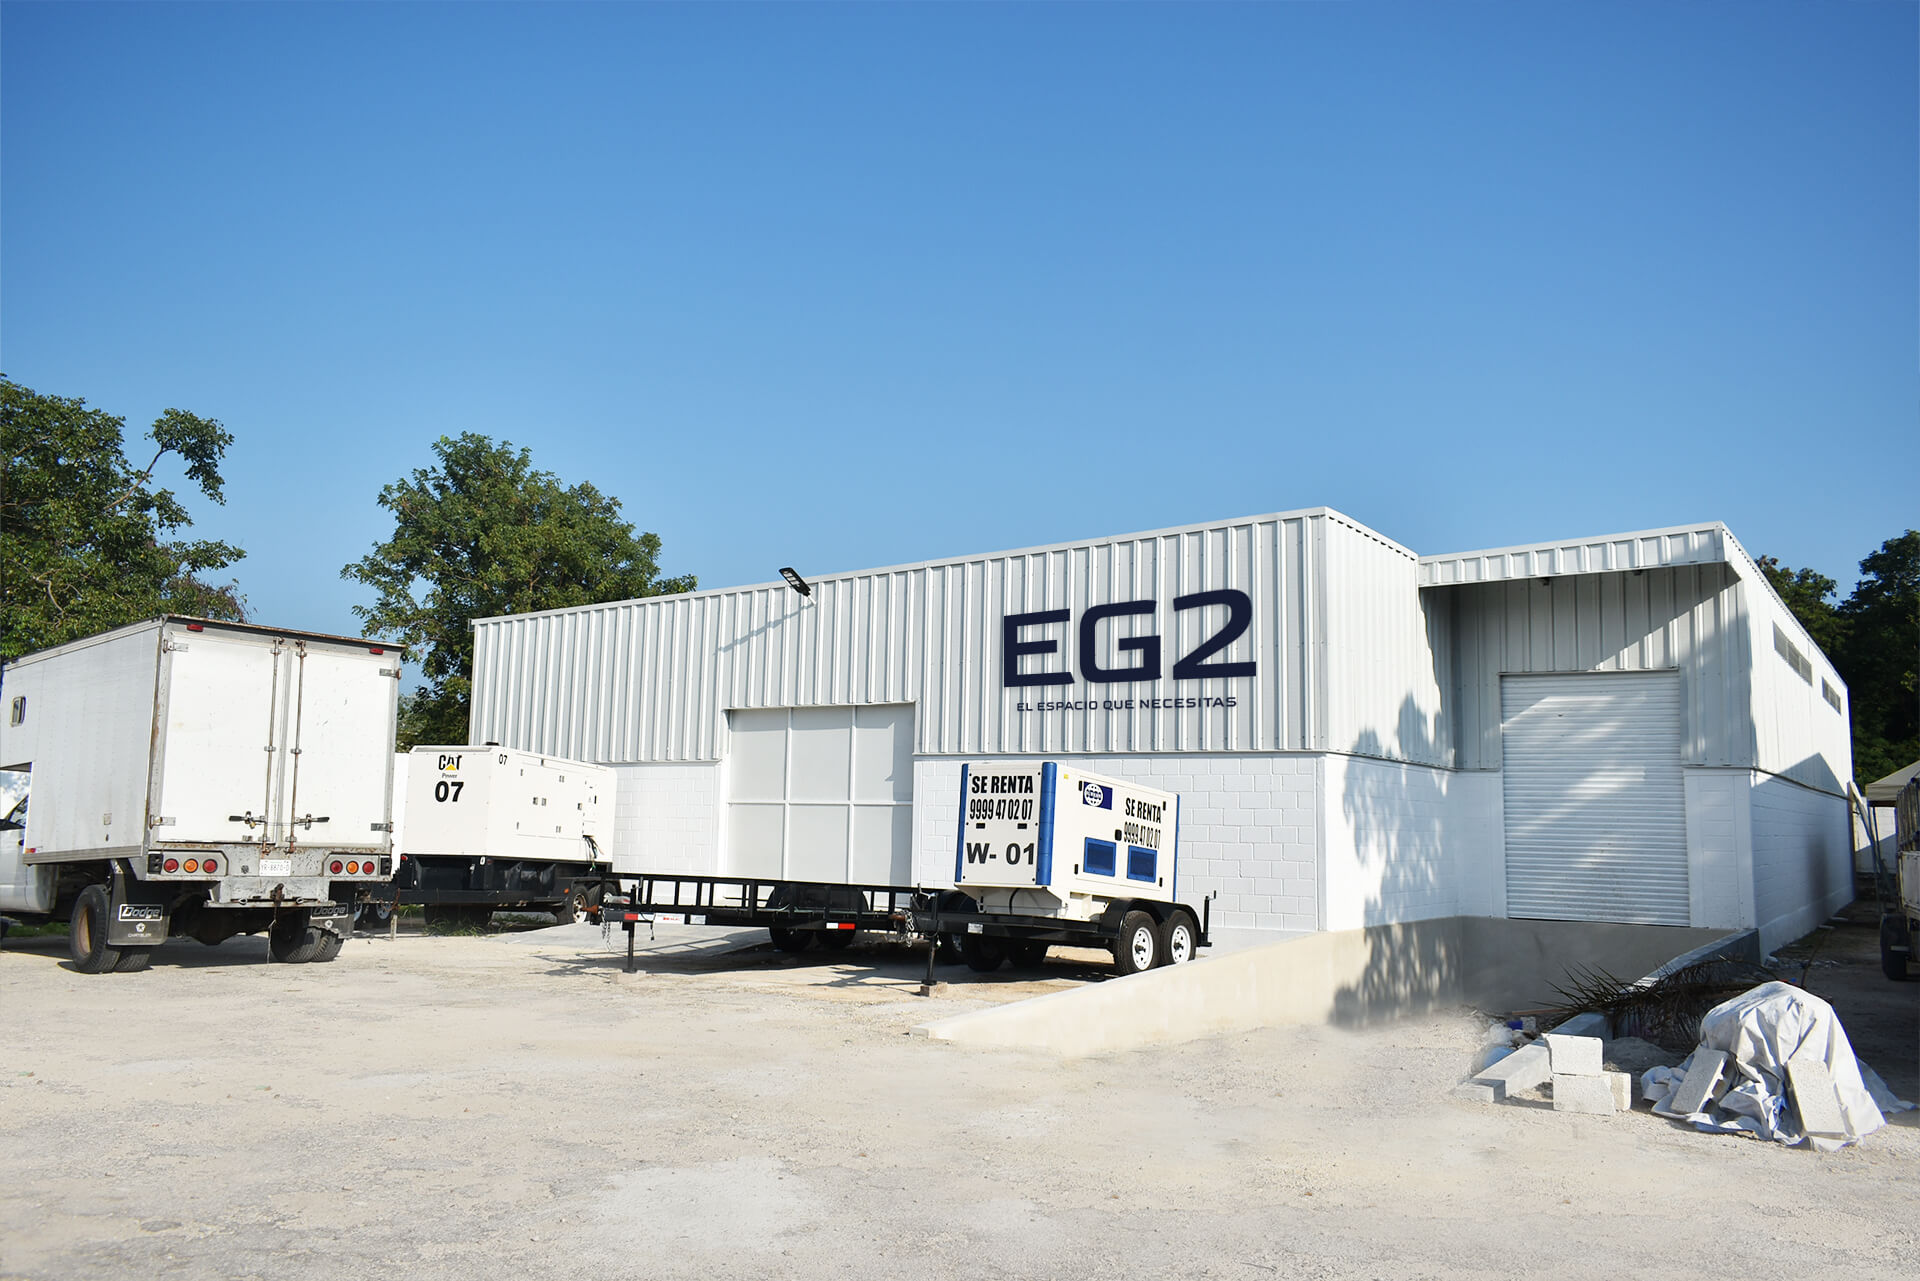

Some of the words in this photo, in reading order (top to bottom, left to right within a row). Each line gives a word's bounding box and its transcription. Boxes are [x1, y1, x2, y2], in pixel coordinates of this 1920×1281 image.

[1003, 588, 1257, 687] EG2
[1017, 702, 1033, 711] EL
[1037, 701, 1098, 711] ESPACIO
[1103, 699, 1134, 711] QUE
[1140, 697, 1237, 709] NECESITAS
[438, 755, 462, 771] CAT
[498, 753, 508, 765] 07
[434, 781, 464, 802] 07
[971, 776, 988, 793] SE
[991, 775, 1033, 793] RENTA
[969, 799, 994, 820] 9999
[995, 799, 1006, 820] 47
[1007, 799, 1020, 820] 02
[1021, 799, 1033, 820] 07
[1125, 797, 1136, 817] SE
[1136, 800, 1161, 824] RENTA
[1124, 821, 1139, 845] 9999
[1139, 825, 1146, 846] 47
[1146, 827, 1154, 848] 02
[1154, 828, 1161, 849] 07
[1006, 842, 1034, 865] 01
[121, 906, 160, 919] Dodge
[313, 905, 346, 916] Dodge
